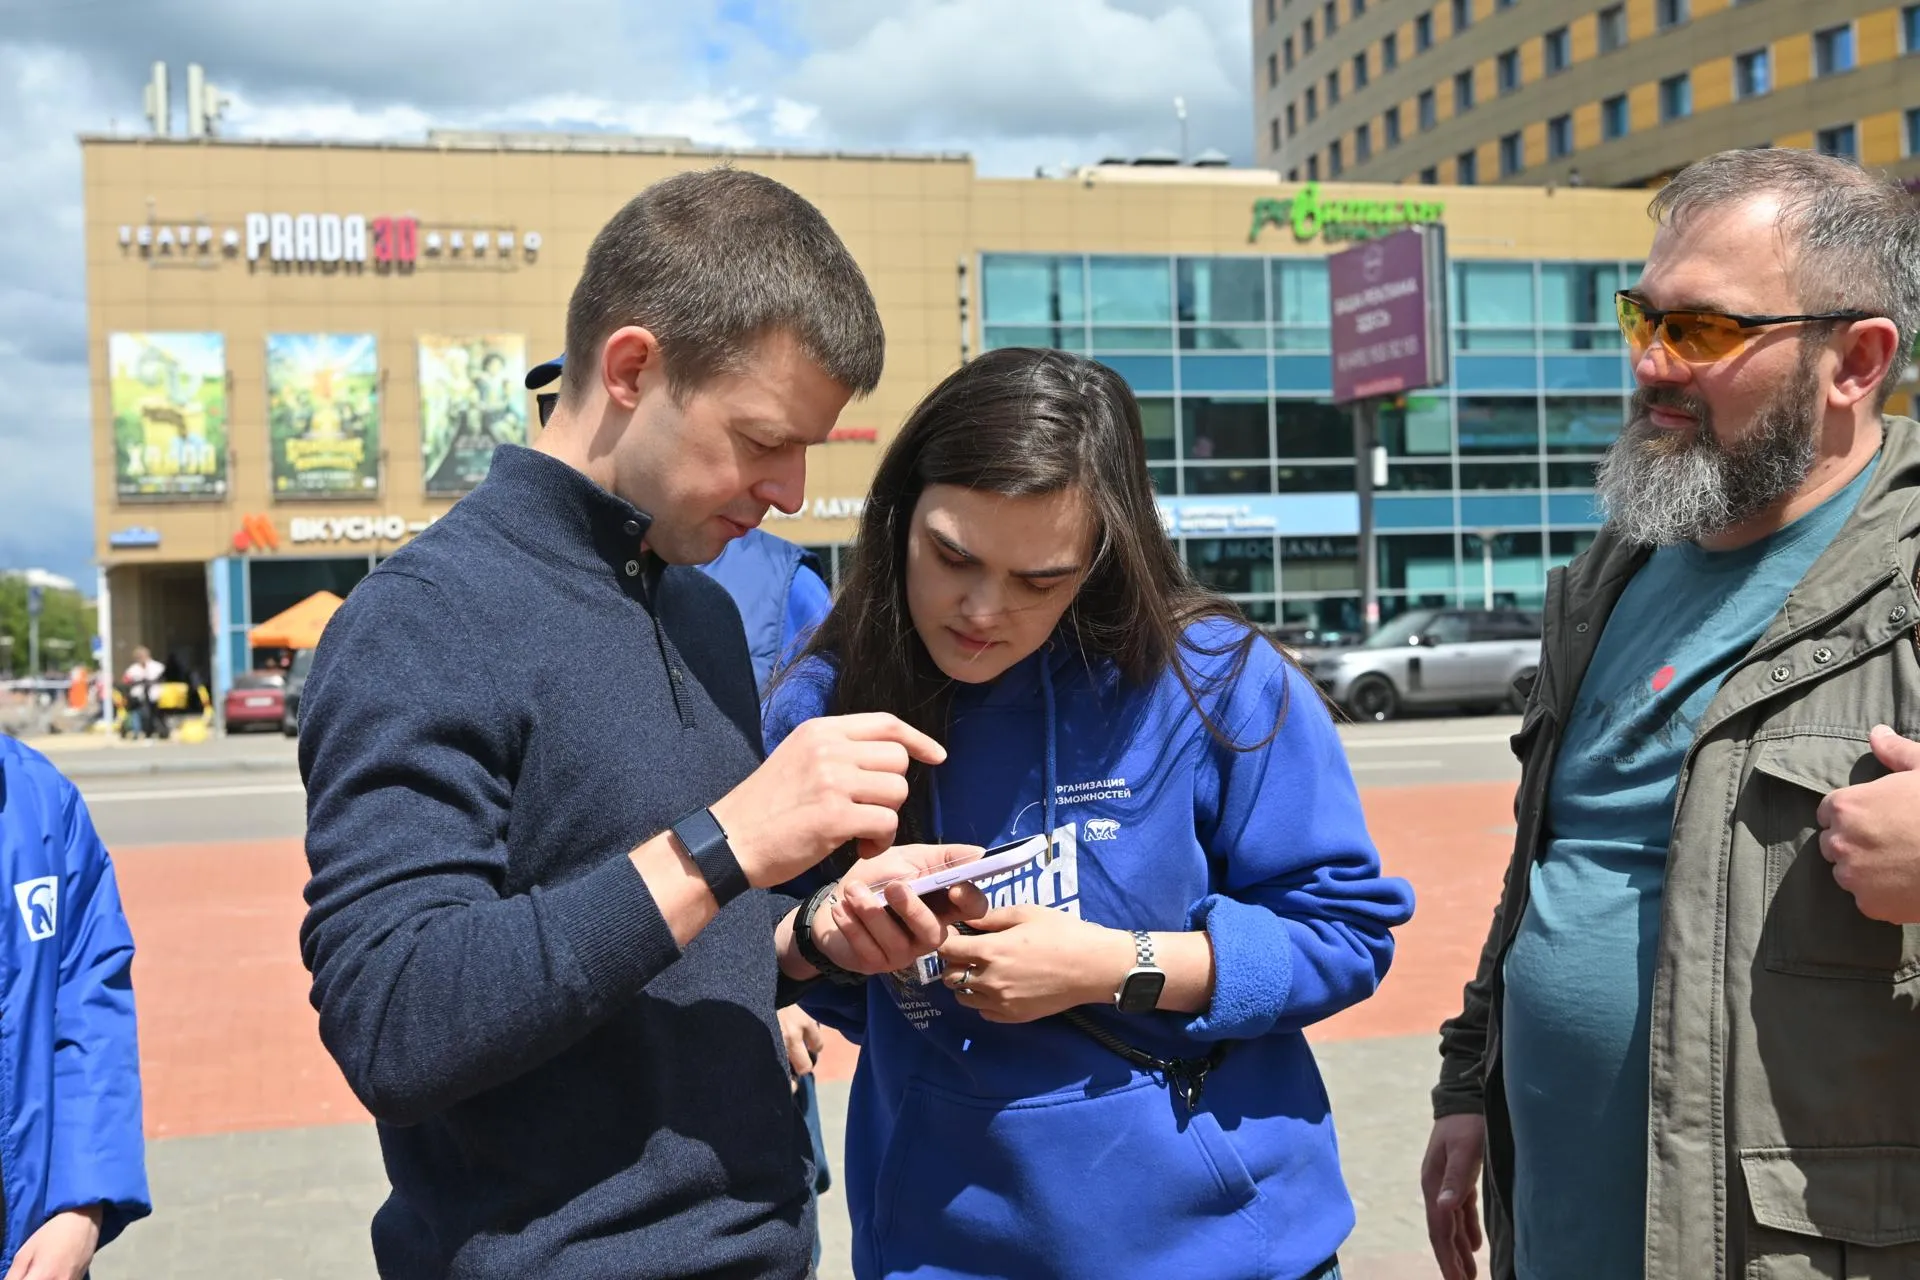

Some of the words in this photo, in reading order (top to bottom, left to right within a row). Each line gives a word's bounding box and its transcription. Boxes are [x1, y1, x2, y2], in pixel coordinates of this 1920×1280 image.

[118, 226, 212, 245] ТЕАТР
[246, 213, 366, 261] PRADA
[373, 217, 417, 261] 3D
[451, 231, 542, 249] КИНО
[290, 516, 405, 542] ВКУСНО
[1043, 788, 1131, 806] ЗМОЖНОСТЕЙ
[904, 1009, 941, 1020] ОЩАТЬ
